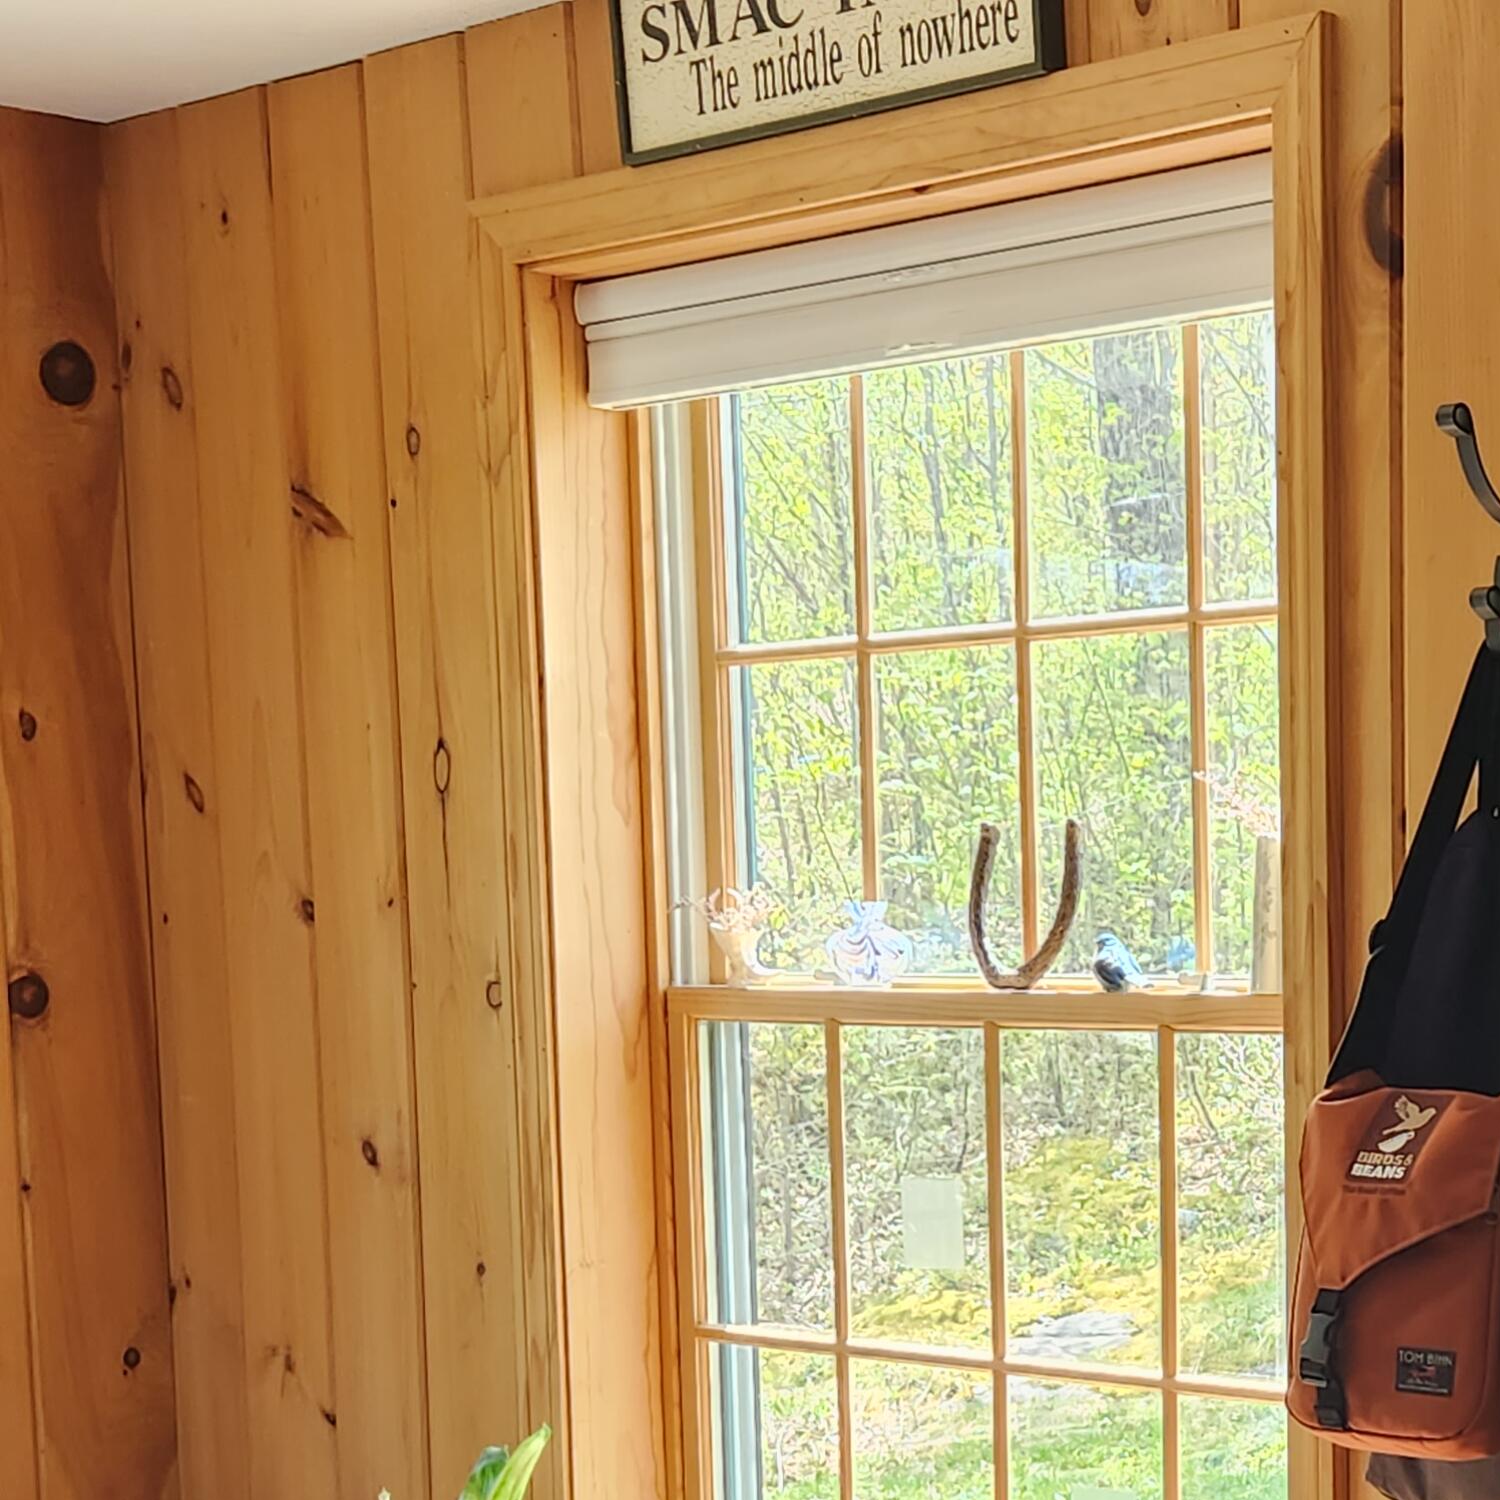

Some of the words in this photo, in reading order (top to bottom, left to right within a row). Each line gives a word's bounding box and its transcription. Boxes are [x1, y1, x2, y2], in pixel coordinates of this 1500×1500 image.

[689, 57, 740, 116] The
[753, 24, 842, 103] middle
[857, 10, 882, 79] of
[901, 0, 1019, 69] nowhere
[1357, 1151, 1404, 1166] BIRDS
[1350, 1163, 1406, 1179] BEANS
